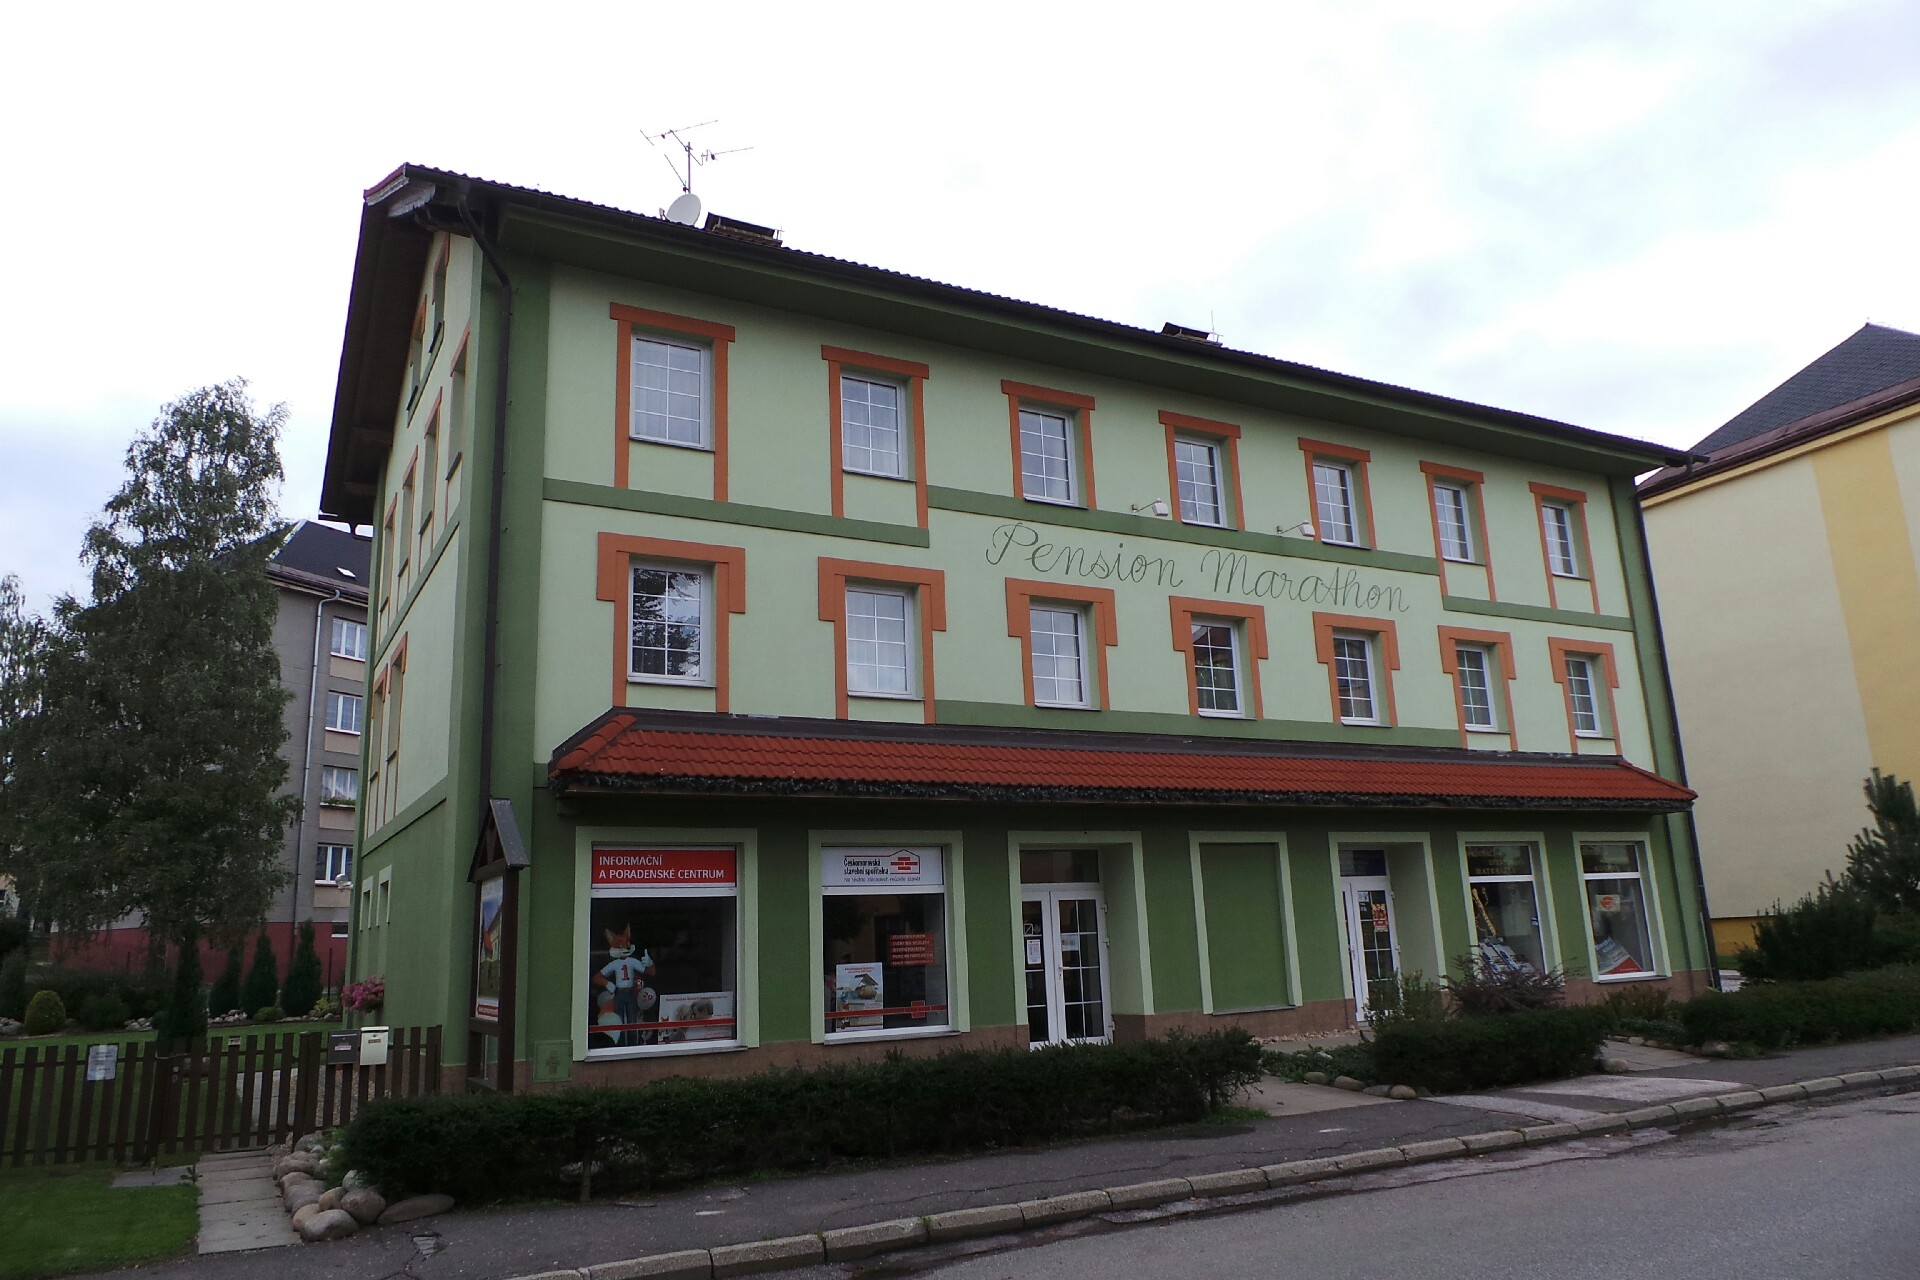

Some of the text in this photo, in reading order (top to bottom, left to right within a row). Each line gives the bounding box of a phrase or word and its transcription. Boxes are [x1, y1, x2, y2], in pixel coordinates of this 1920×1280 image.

[985, 521, 1410, 613] Pension Marathon
[599, 854, 663, 866] INFORMAČNÍ
[843, 857, 881, 867] Českomoravská
[599, 867, 724, 879] A PORADENSKÉ CENTRUM
[844, 866, 889, 876] stavební spořitelna
[621, 964, 630, 981] 1
